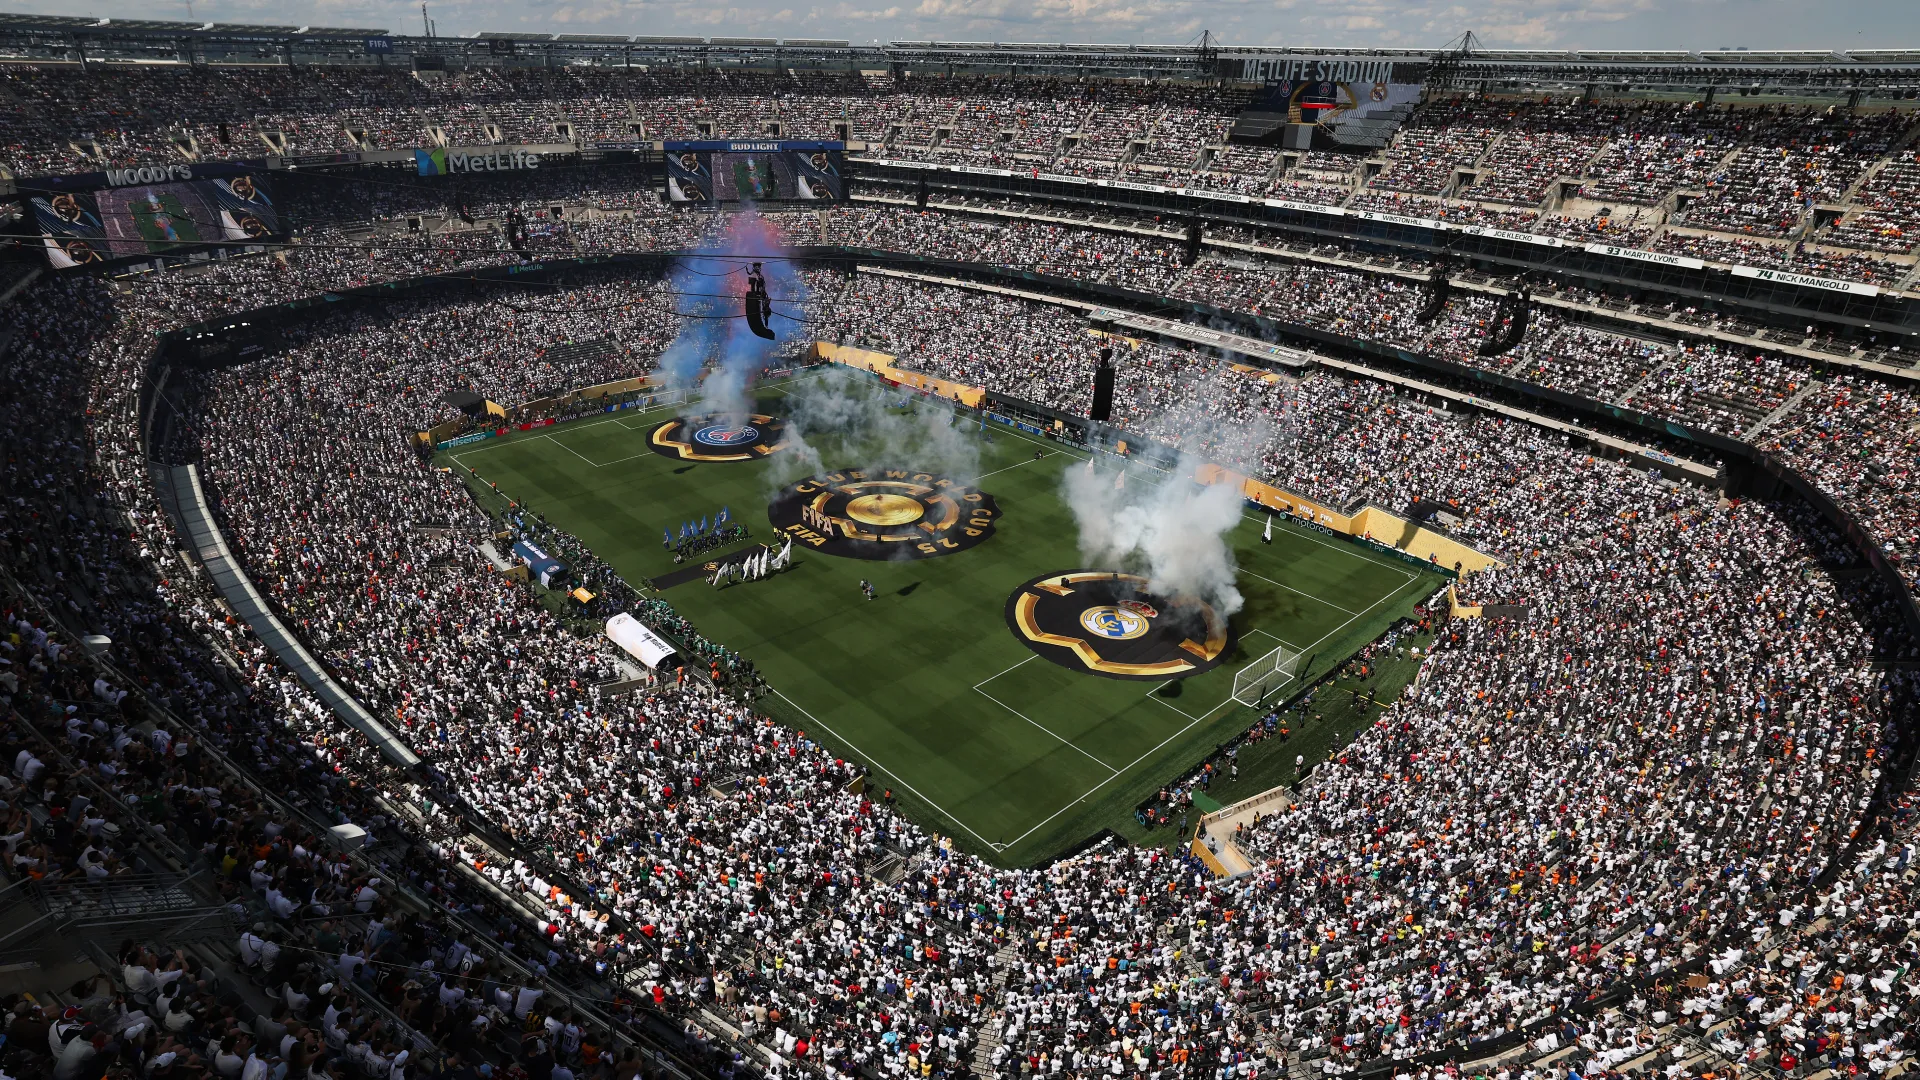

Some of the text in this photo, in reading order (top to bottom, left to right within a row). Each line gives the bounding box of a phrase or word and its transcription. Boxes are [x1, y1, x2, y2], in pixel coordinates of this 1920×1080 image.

[369, 40, 388, 48] FIFA
[1243, 59, 1393, 84] METLIFE STADIUM
[730, 143, 779, 151] BUD LIGHT
[449, 149, 540, 173] MetLife
[106, 164, 193, 187] MOODY'S
[1363, 211, 1422, 226] 75 WINSTON HILL
[1506, 232, 1533, 242] KLECKO
[1605, 246, 1679, 265] 93 MARTY LYONS
[519, 263, 543, 273] MetLife
[1756, 269, 1850, 291] 74 NICK MANGOLD
[1171, 325, 1221, 340] METLIFE STADIUM
[555, 407, 605, 423] QATAR AIRWAYS
[993, 414, 1006, 423] VISA
[1022, 424, 1035, 433] VISA
[1568, 427, 1590, 438] verizon
[448, 433, 486, 448] Hisense
[1645, 450, 1675, 465] HCLTech
[796, 471, 868, 493] CLUB
[1298, 503, 1315, 516] VISA
[802, 504, 834, 536] FIFA
[963, 508, 992, 537] CUP
[1319, 513, 1333, 523] FIFA
[1292, 516, 1333, 536] motorola
[786, 524, 827, 547] FIFA
[1374, 545, 1385, 553] PIF
[1403, 554, 1415, 563] PIF
[1432, 564, 1445, 573] PIF
[193, 818, 201, 827] 9
[368, 928, 375, 941] 7
[376, 970, 389, 985] 17
